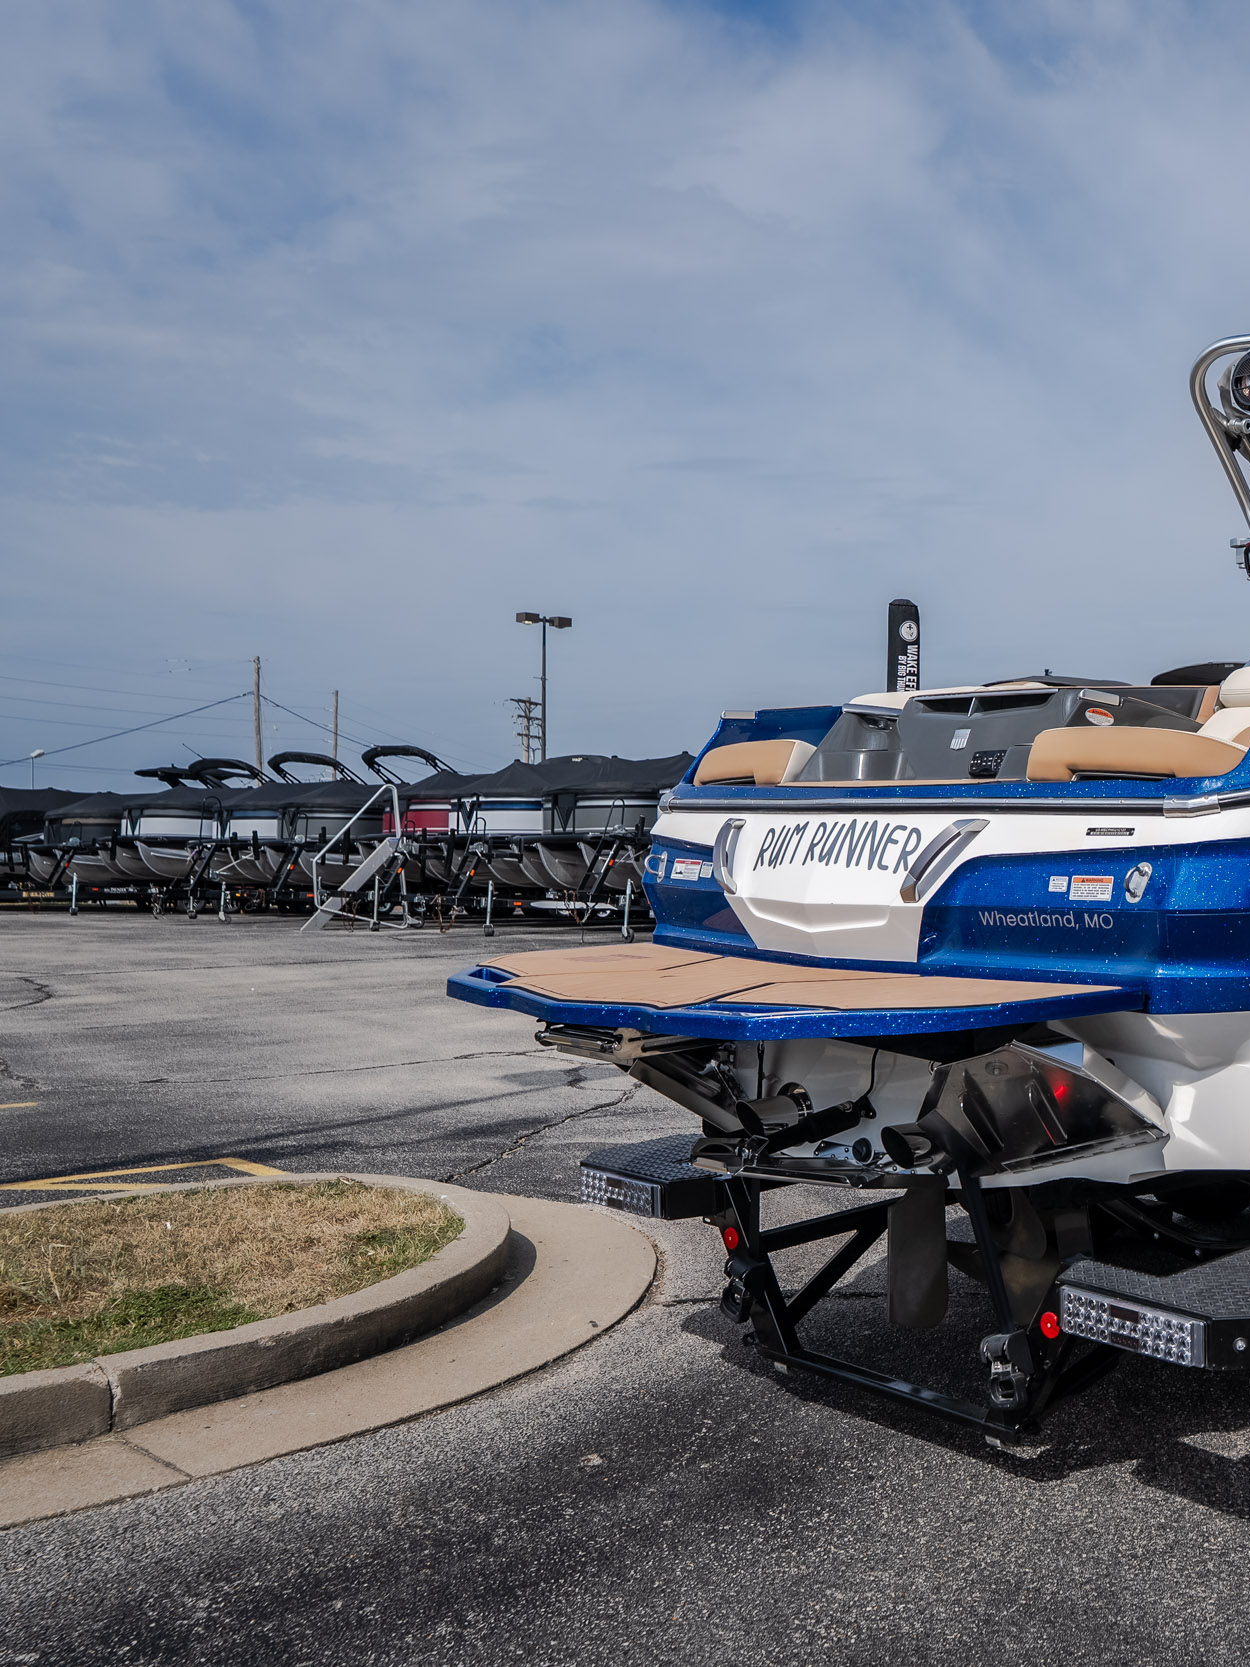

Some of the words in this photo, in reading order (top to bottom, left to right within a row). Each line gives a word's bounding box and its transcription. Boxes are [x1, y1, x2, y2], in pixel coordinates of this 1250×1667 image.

[898, 655, 906, 664] BY
[907, 645, 918, 674] WAKE
[898, 665, 906, 676] BIG
[752, 821, 810, 872] RUM
[801, 818, 922, 874] RUNNER
[978, 910, 1080, 931] Wheatland,
[1083, 912, 1114, 929] MO
